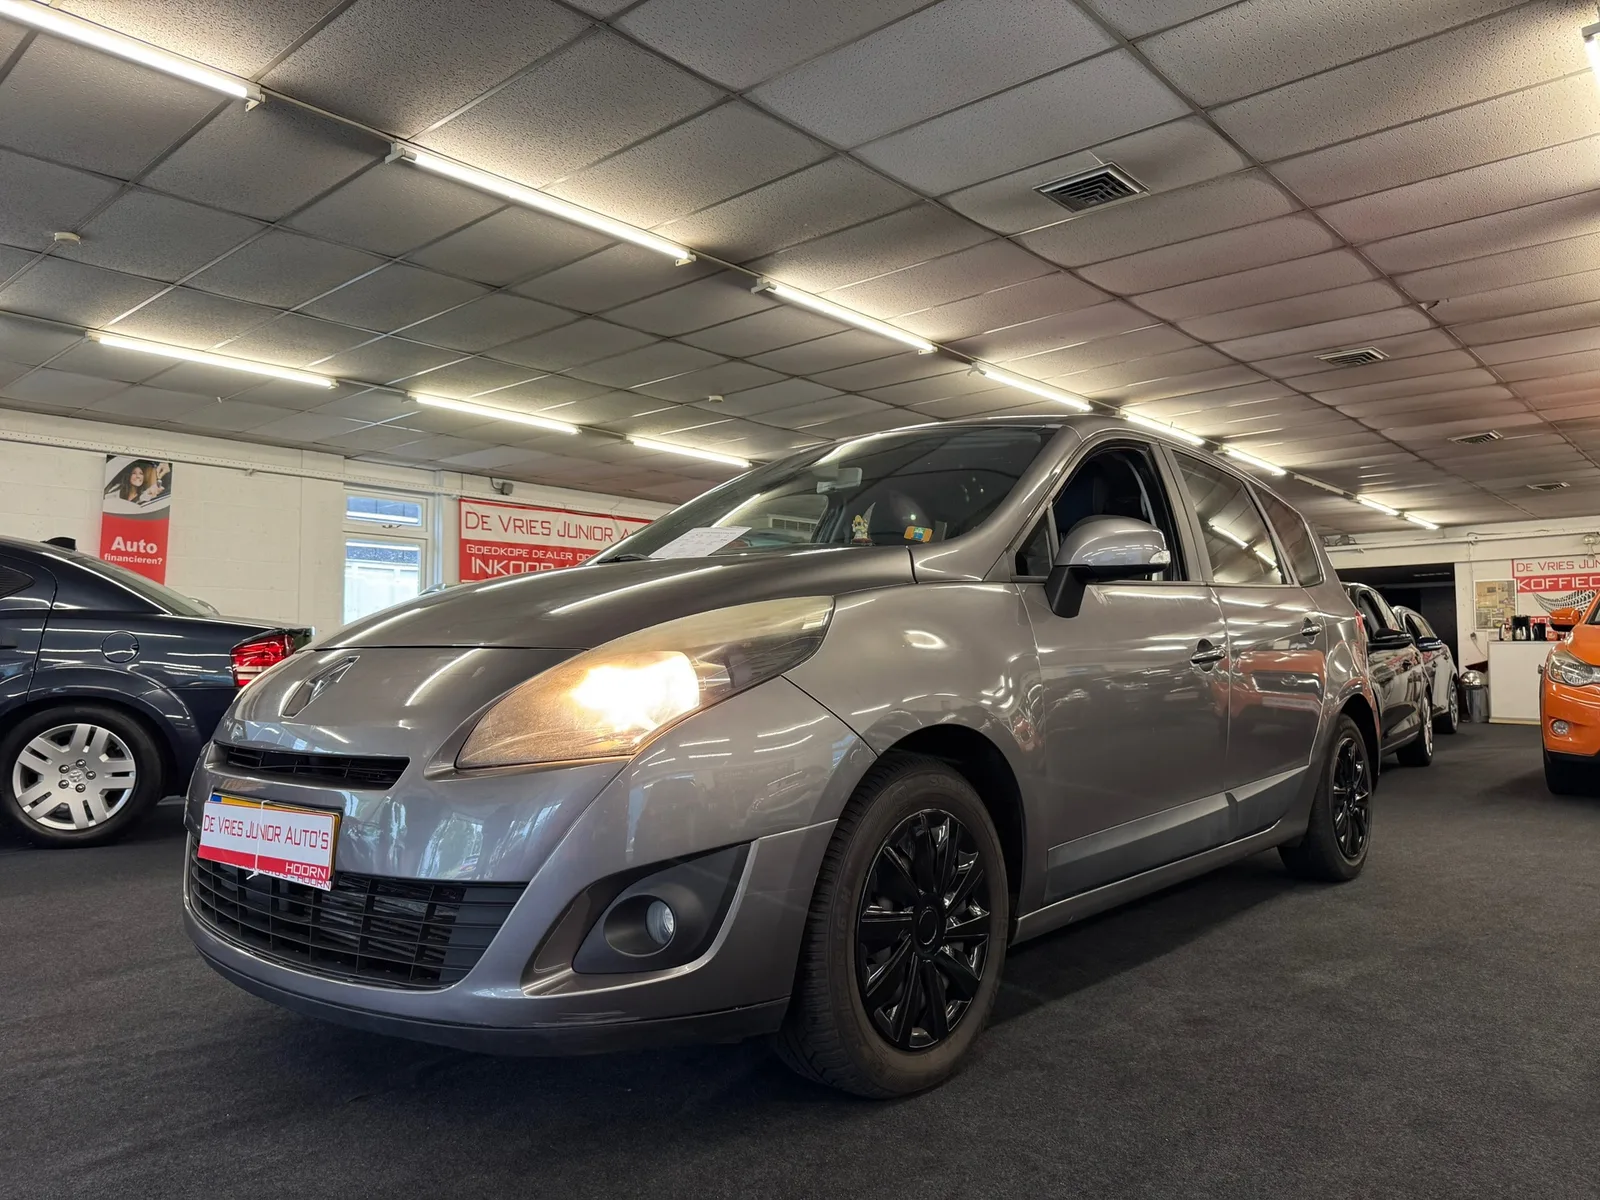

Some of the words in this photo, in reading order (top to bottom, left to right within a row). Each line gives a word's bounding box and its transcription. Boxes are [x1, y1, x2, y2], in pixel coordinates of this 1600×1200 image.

[465, 511, 492, 532] DE
[498, 515, 551, 536] VRIES
[557, 521, 614, 543] JUNIOR
[111, 536, 157, 554] Auto
[466, 544, 530, 558] GOEDKOPE
[532, 550, 573, 561] DEALER
[104, 553, 162, 564] financieren?
[1516, 563, 1532, 572] DE
[1538, 561, 1574, 570] VRIES
[203, 815, 215, 832] DE
[218, 817, 243, 836] VRIES
[246, 821, 281, 842] JUNIOR
[285, 826, 329, 849] AUTO'S
[285, 862, 327, 879] HOORN
